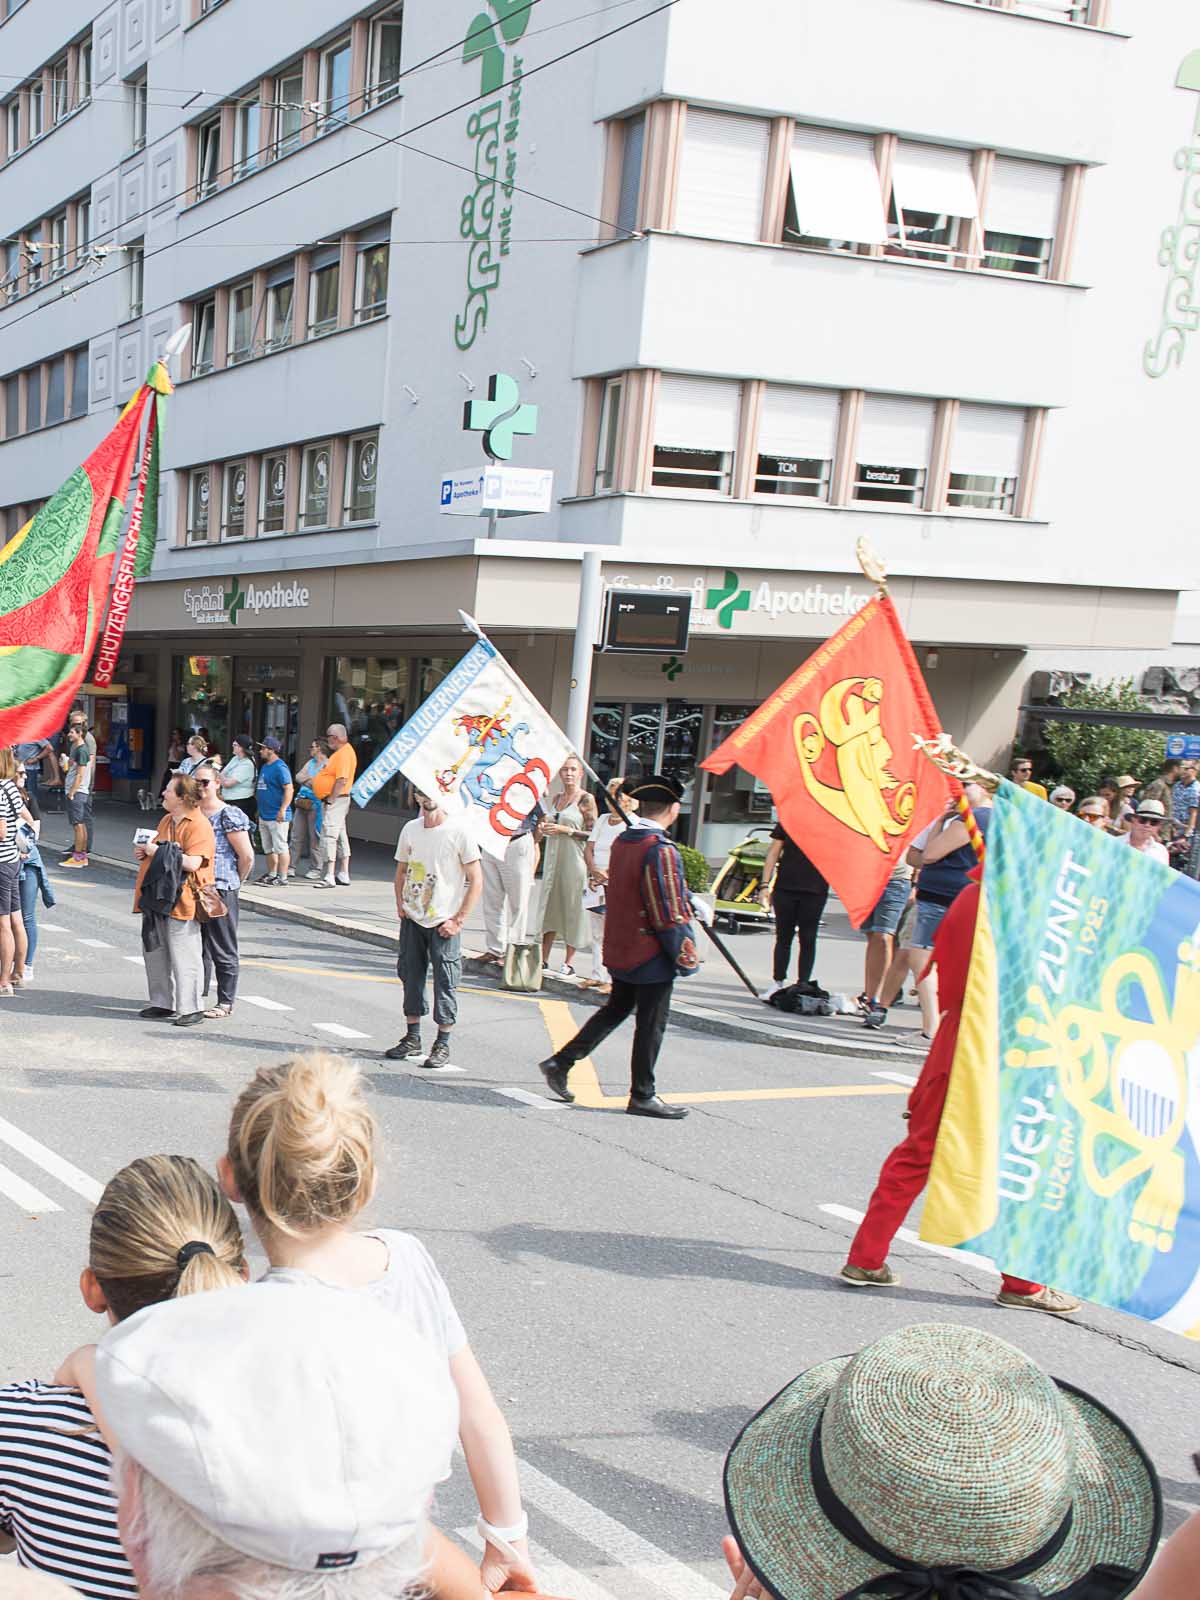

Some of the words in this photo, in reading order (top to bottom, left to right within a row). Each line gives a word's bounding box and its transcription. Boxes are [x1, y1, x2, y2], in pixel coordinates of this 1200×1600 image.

[504, 54, 525, 144] Natur
[503, 148, 518, 199] der
[454, 99, 502, 352] Späni
[500, 205, 513, 257] mit
[778, 462, 797, 473] TCM
[184, 585, 224, 618] Späni
[245, 581, 310, 615] Apotheke
[357, 731, 417, 799] FIDELITAS
[411, 649, 489, 736] LUCERNENSIS
[999, 1084, 1056, 1202] WEY-
[1037, 848, 1093, 996] ZUNFT
